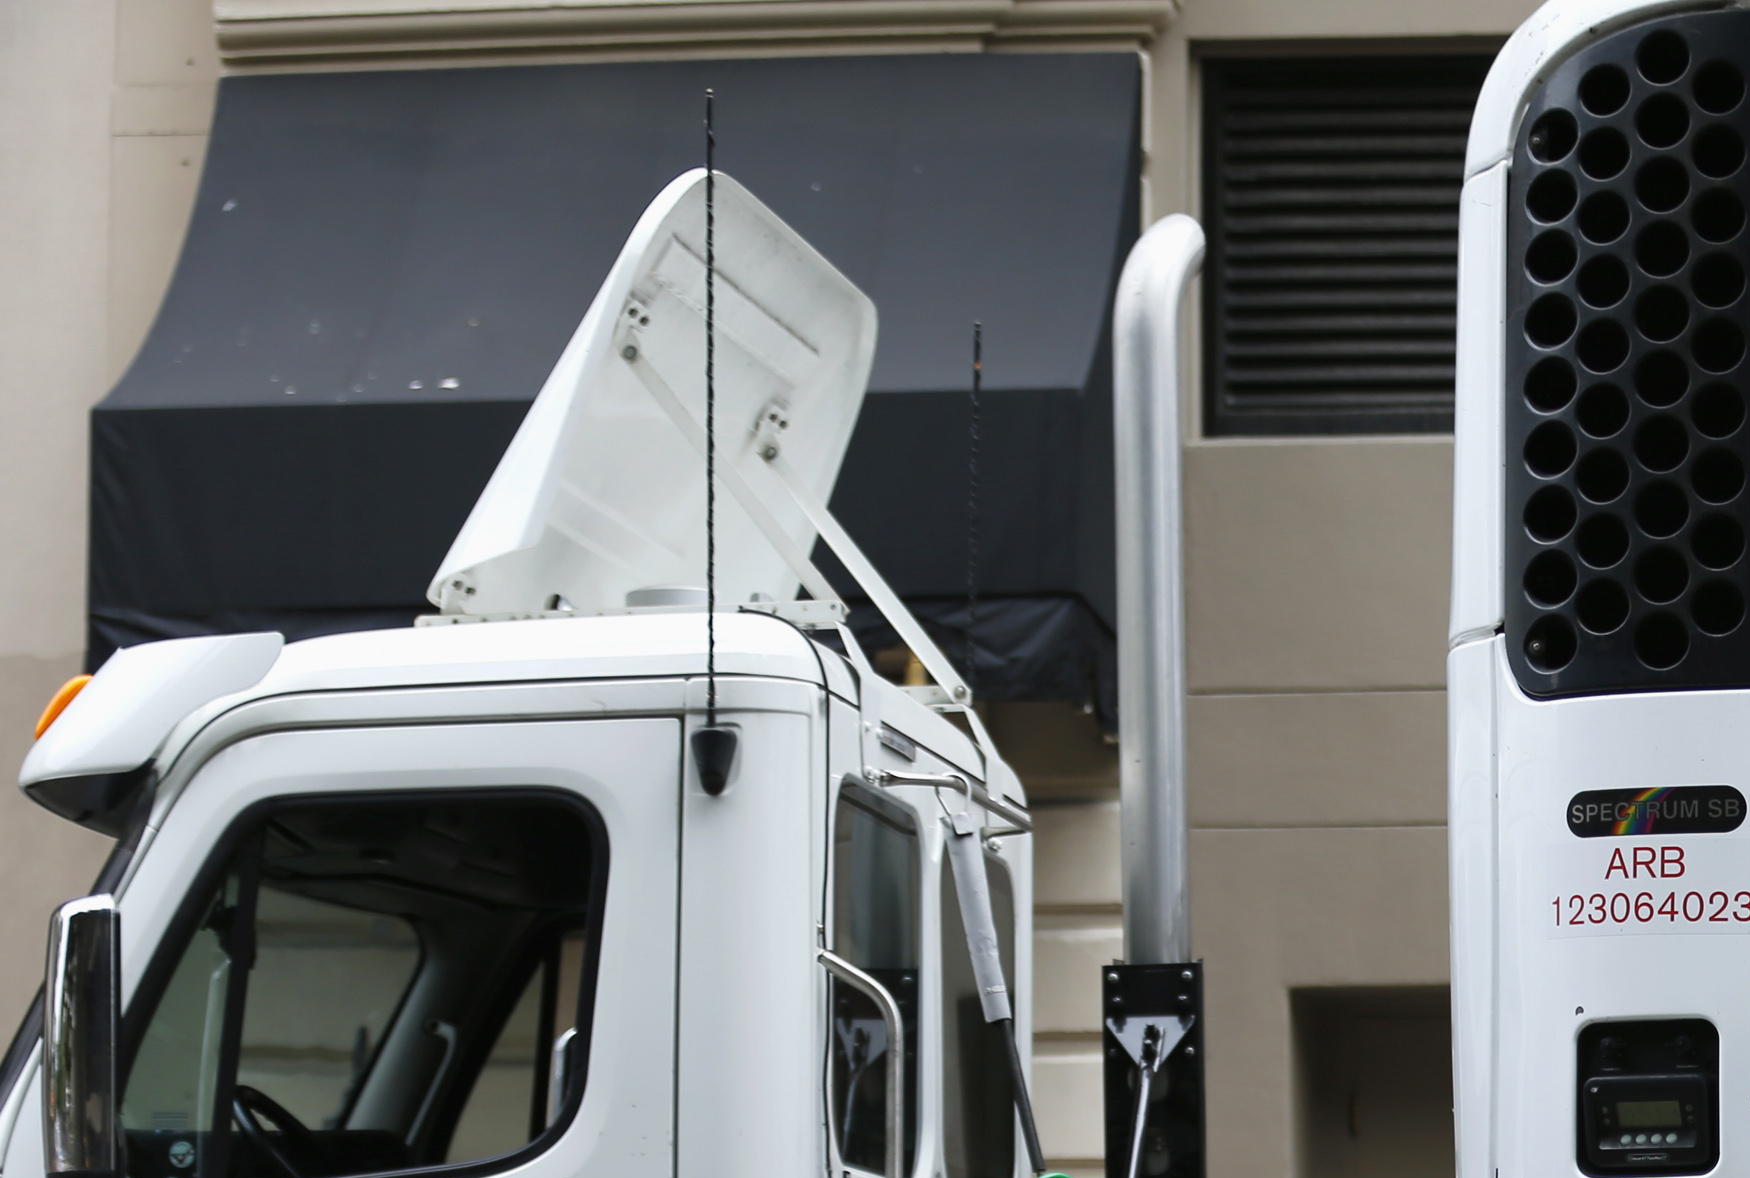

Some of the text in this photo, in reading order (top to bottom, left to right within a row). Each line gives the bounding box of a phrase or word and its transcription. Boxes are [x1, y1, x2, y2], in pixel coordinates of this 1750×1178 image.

[1571, 799, 1740, 824] SPECTRUM SB
[1604, 845, 1686, 880] ARB
